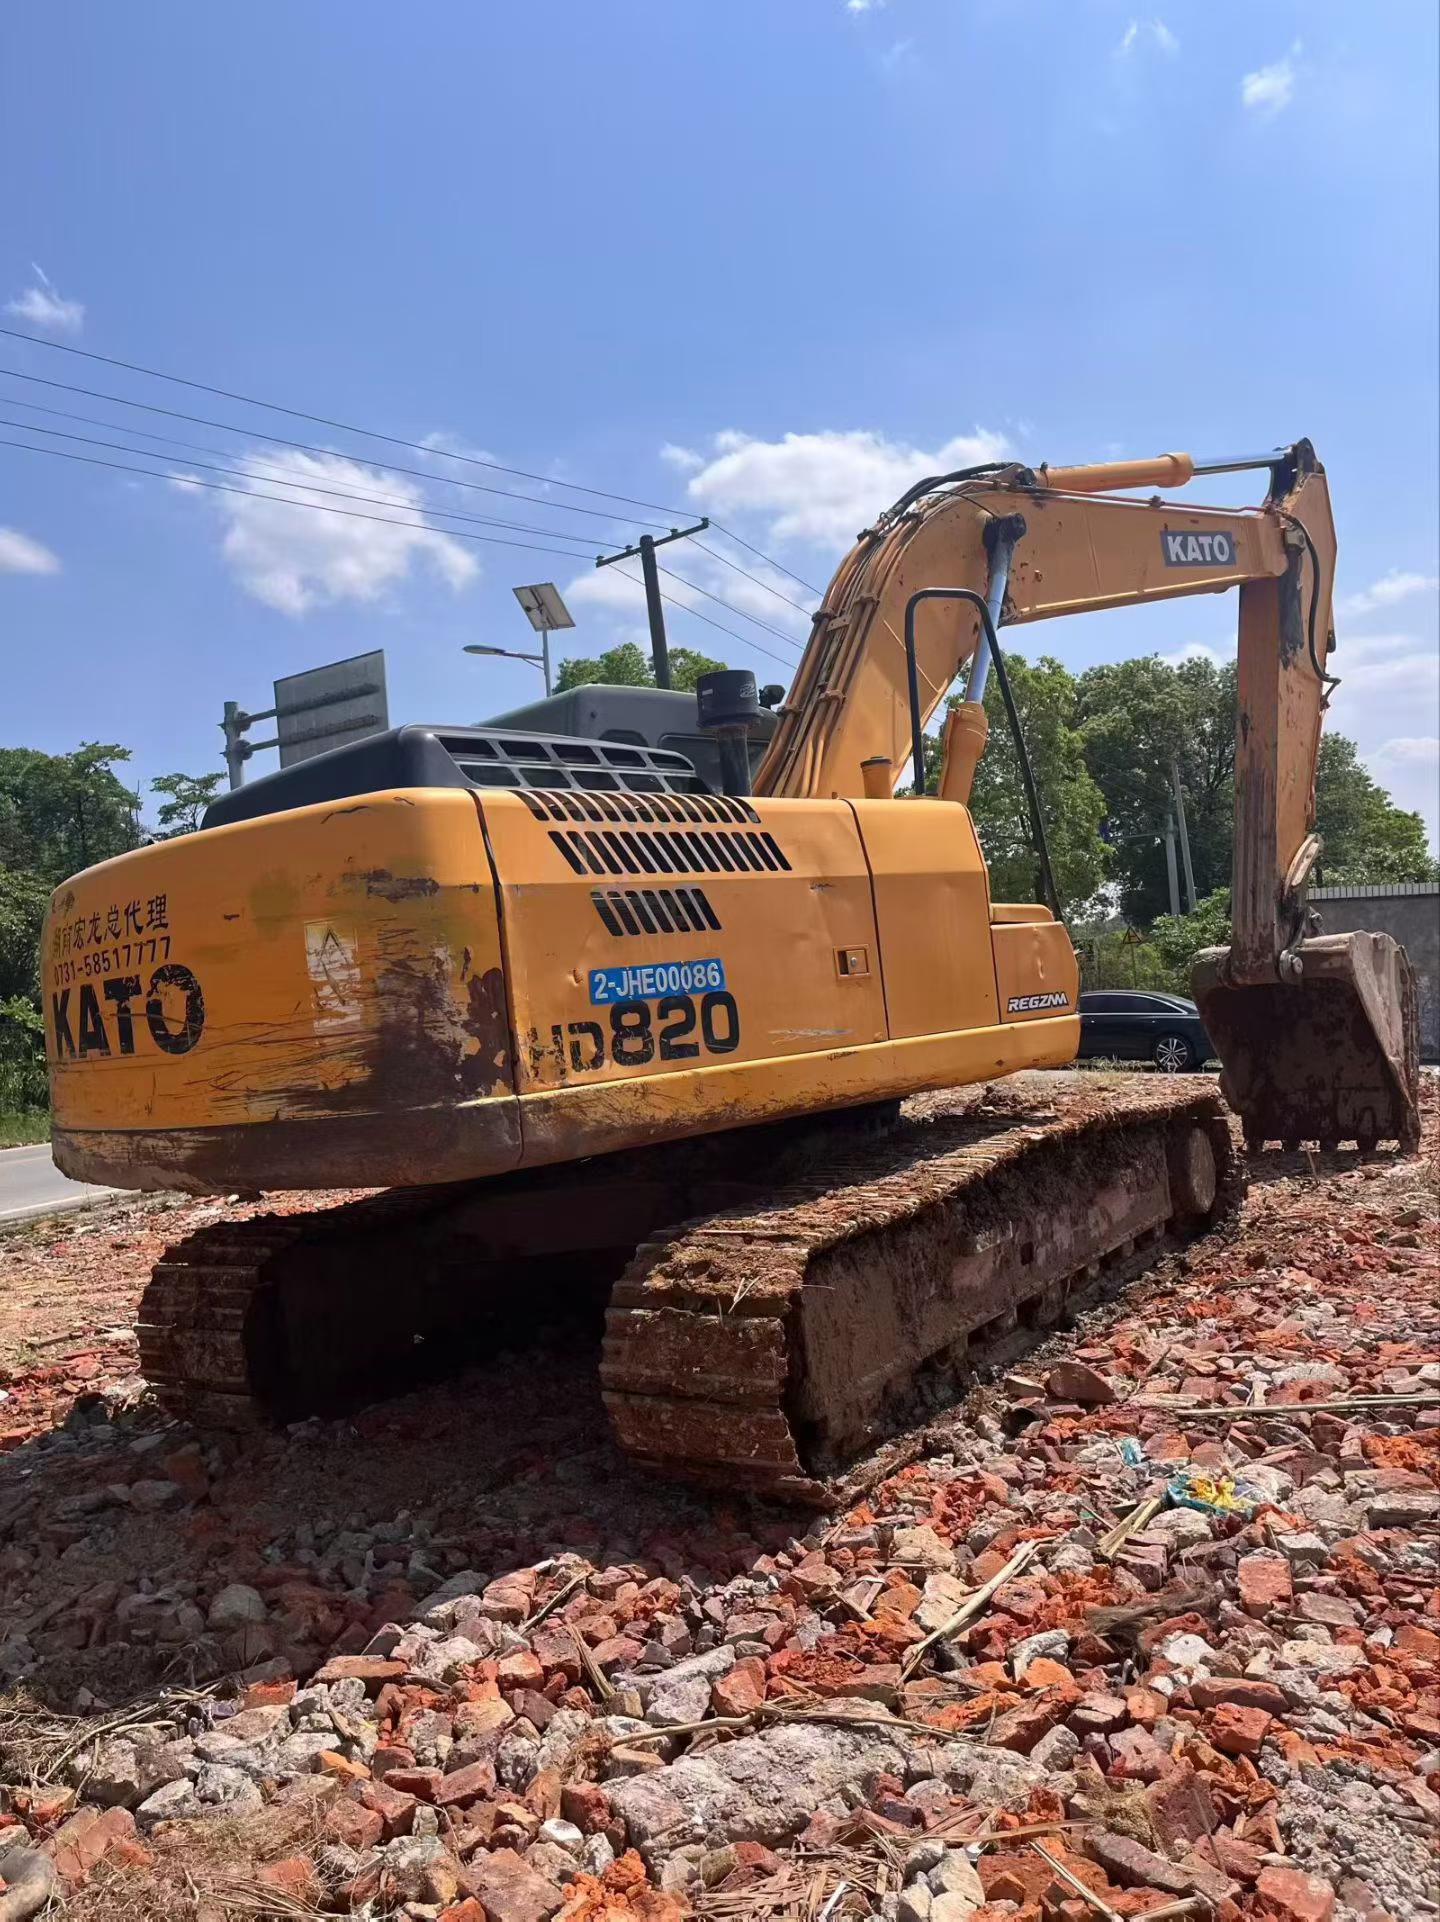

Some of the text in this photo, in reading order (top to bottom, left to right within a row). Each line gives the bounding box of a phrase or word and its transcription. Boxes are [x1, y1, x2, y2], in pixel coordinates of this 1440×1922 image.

[1167, 534, 1230, 562] KATO
[54, 936, 171, 986] 0731-58517777
[594, 962, 721, 1000] 2-JHE00086
[52, 963, 205, 1059] KATO
